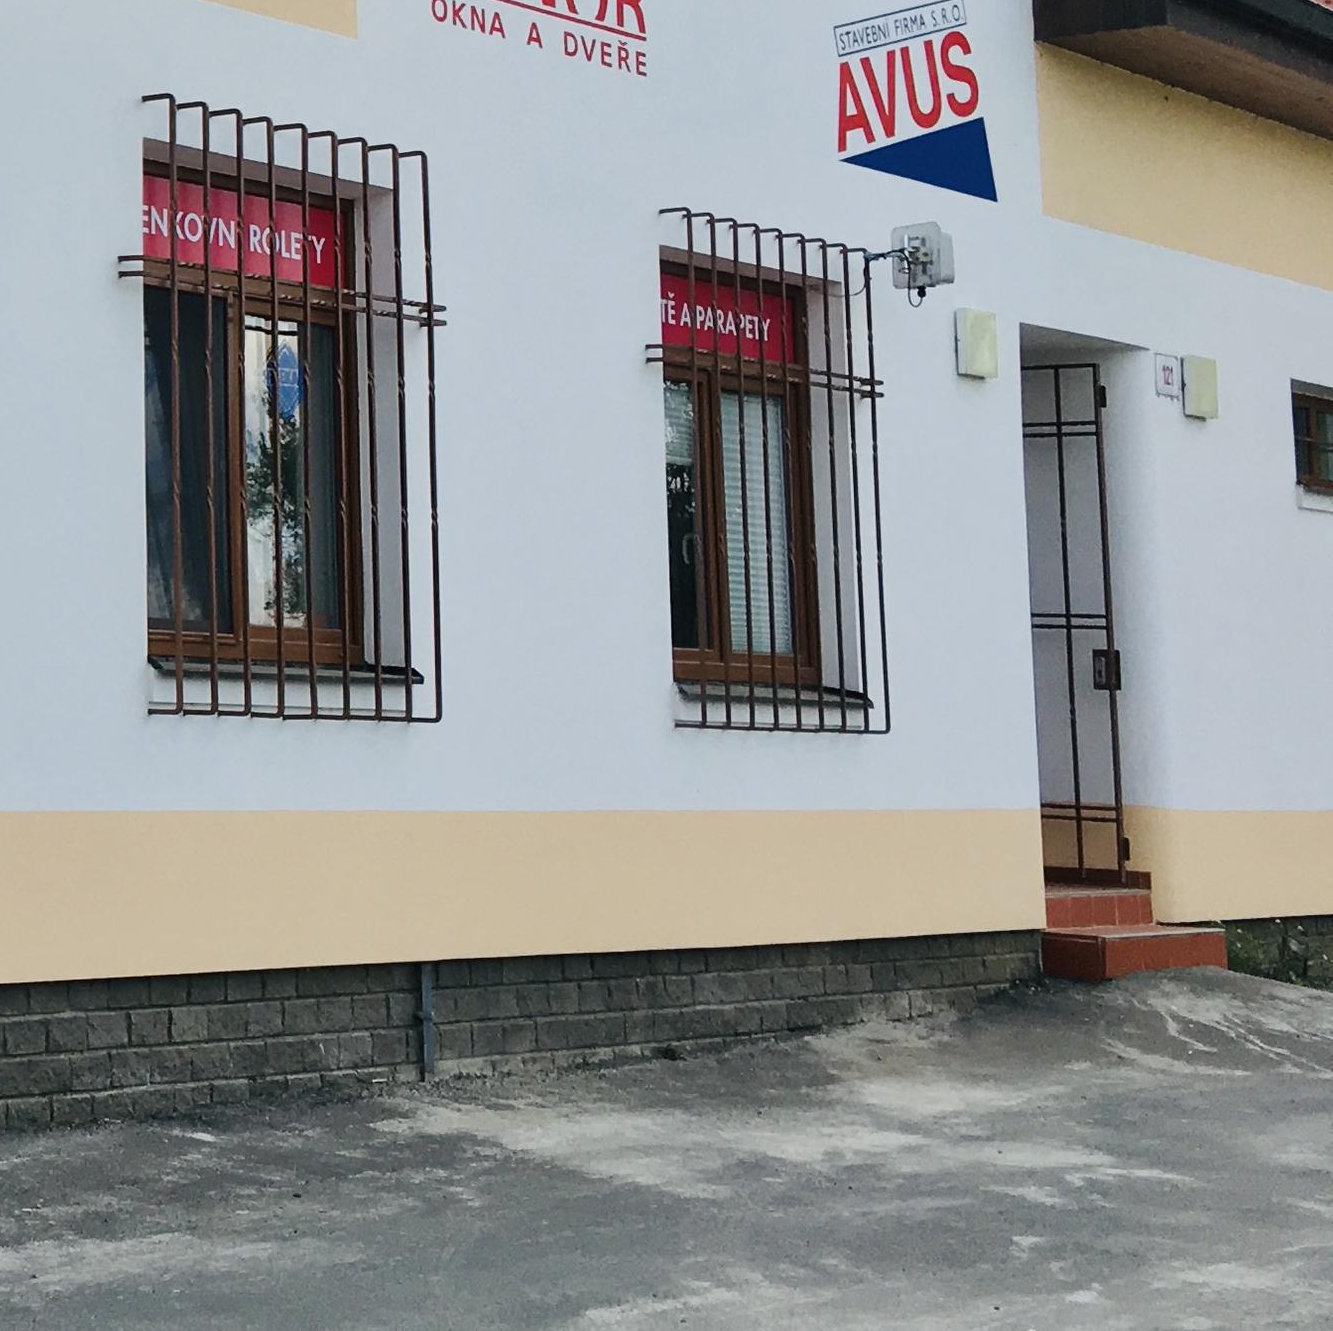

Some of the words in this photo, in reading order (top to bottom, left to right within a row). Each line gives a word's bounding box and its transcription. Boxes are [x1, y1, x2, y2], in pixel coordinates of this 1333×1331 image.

[893, 13, 926, 36] FIRMA
[526, 22, 543, 49] A
[563, 38, 647, 77] DVEŘE
[837, 30, 979, 153] AVUS
[142, 204, 236, 250] ENKOVN
[660, 291, 676, 325] TĚ
[680, 302, 692, 327] A
